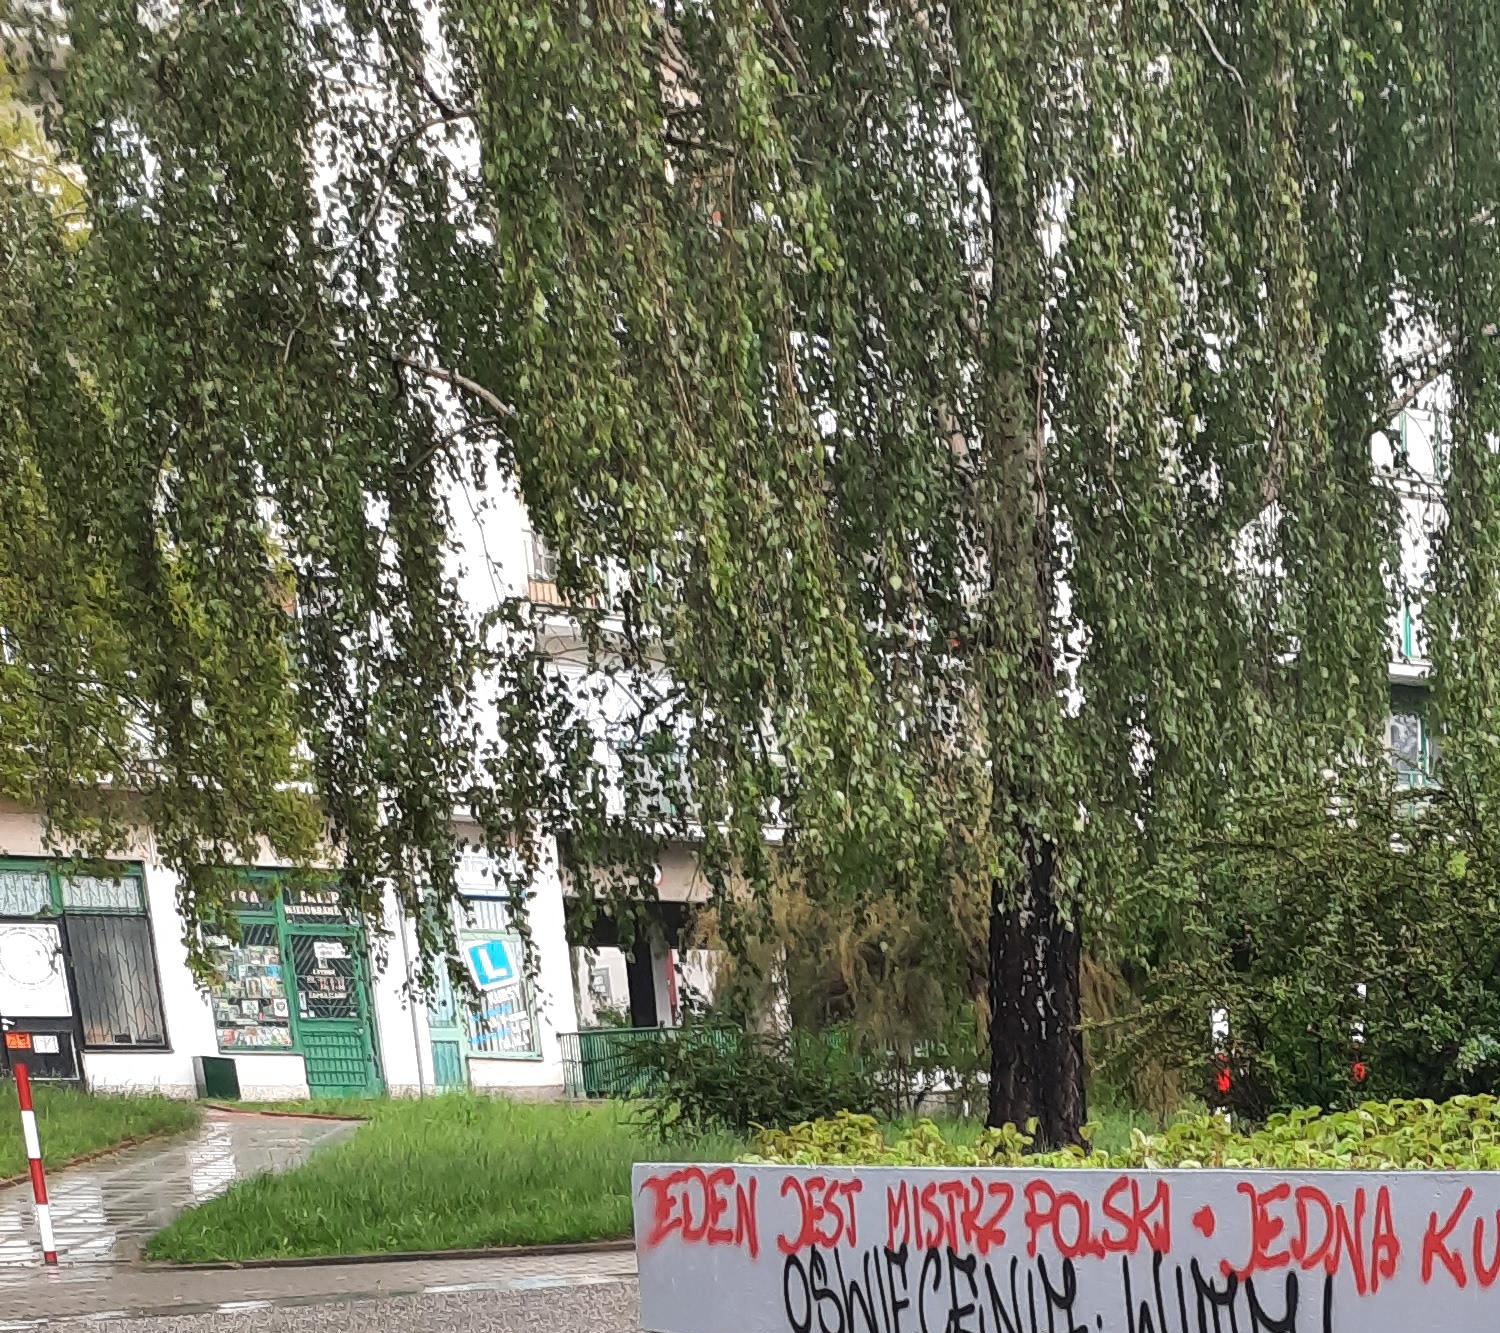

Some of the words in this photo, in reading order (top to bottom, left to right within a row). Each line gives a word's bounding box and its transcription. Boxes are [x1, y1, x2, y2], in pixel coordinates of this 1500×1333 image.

[478, 947, 508, 979] L
[777, 1176, 863, 1256] JEST
[886, 1176, 1014, 1256] MISTRZ
[1220, 1182, 1401, 1296] JEDNA
